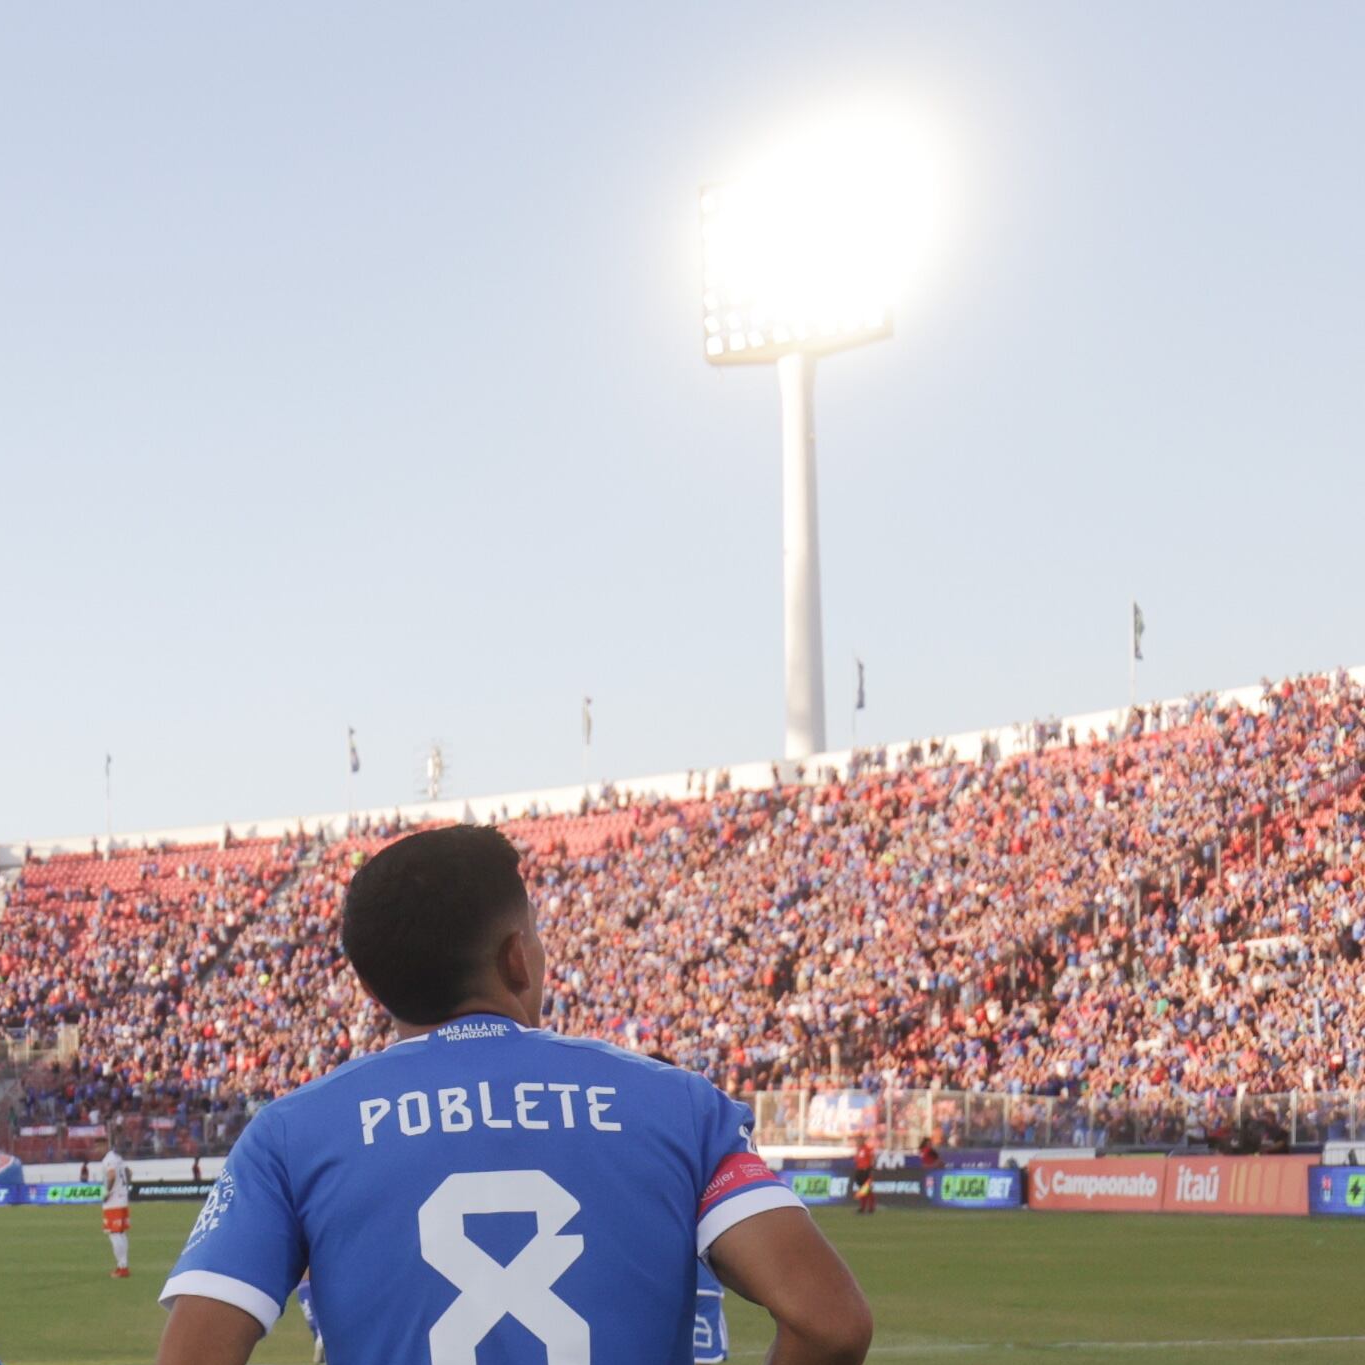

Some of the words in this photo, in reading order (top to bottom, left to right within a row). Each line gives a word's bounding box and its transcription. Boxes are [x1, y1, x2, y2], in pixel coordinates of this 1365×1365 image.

[437, 1025, 461, 1037] MÁS
[462, 1022, 487, 1034] ALLÁ
[489, 1023, 510, 1032] DEL
[445, 1030, 505, 1042] HORIZONTE
[360, 1081, 622, 1145] POBLETE
[1052, 1170, 1157, 1197] Campeonato
[1175, 1164, 1218, 1201] itaú
